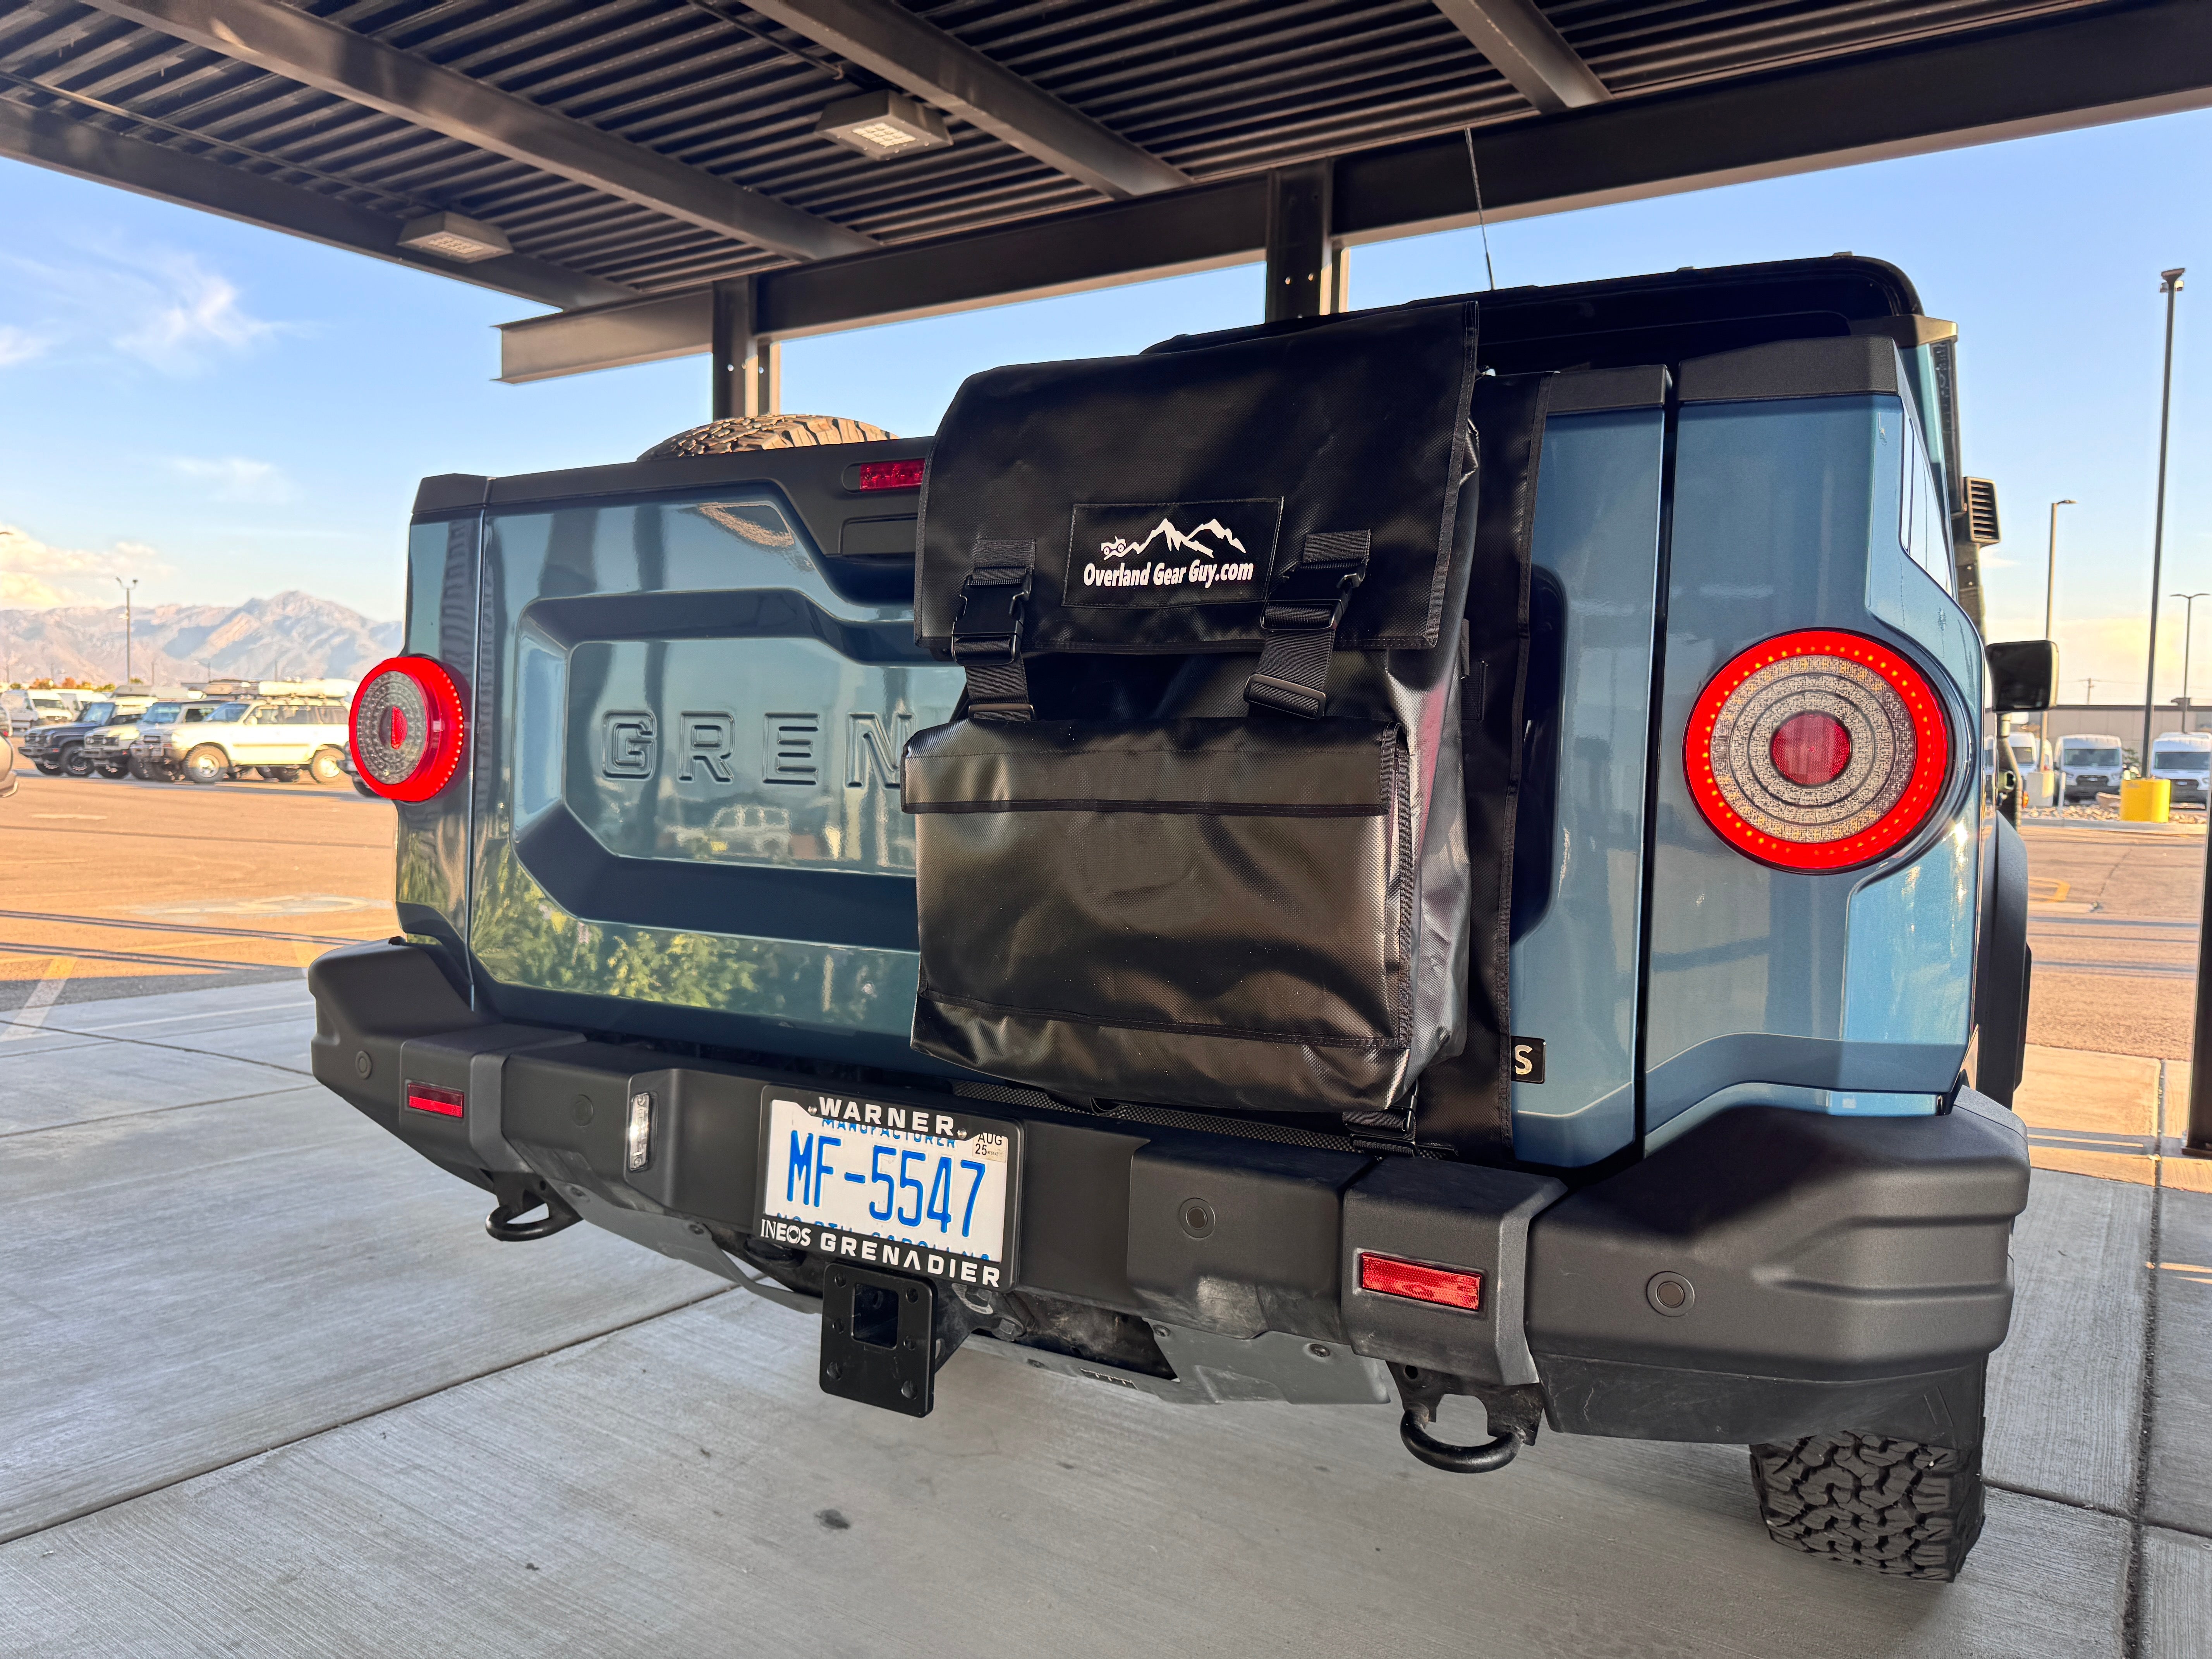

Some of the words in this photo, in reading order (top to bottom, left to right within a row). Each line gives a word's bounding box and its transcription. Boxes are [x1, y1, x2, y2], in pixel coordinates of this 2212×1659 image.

[1084, 562, 1151, 587] Overland
[1153, 563, 1187, 586] Gear
[1188, 559, 1254, 588] Guy.com
[819, 1096, 954, 1136] WARNER
[975, 1143, 987, 1156] 25
[977, 1133, 1002, 1146] AUG
[787, 1130, 986, 1237] MF-5547
[760, 1219, 812, 1246] INEOS
[820, 1232, 1000, 1288] GRENADIER
